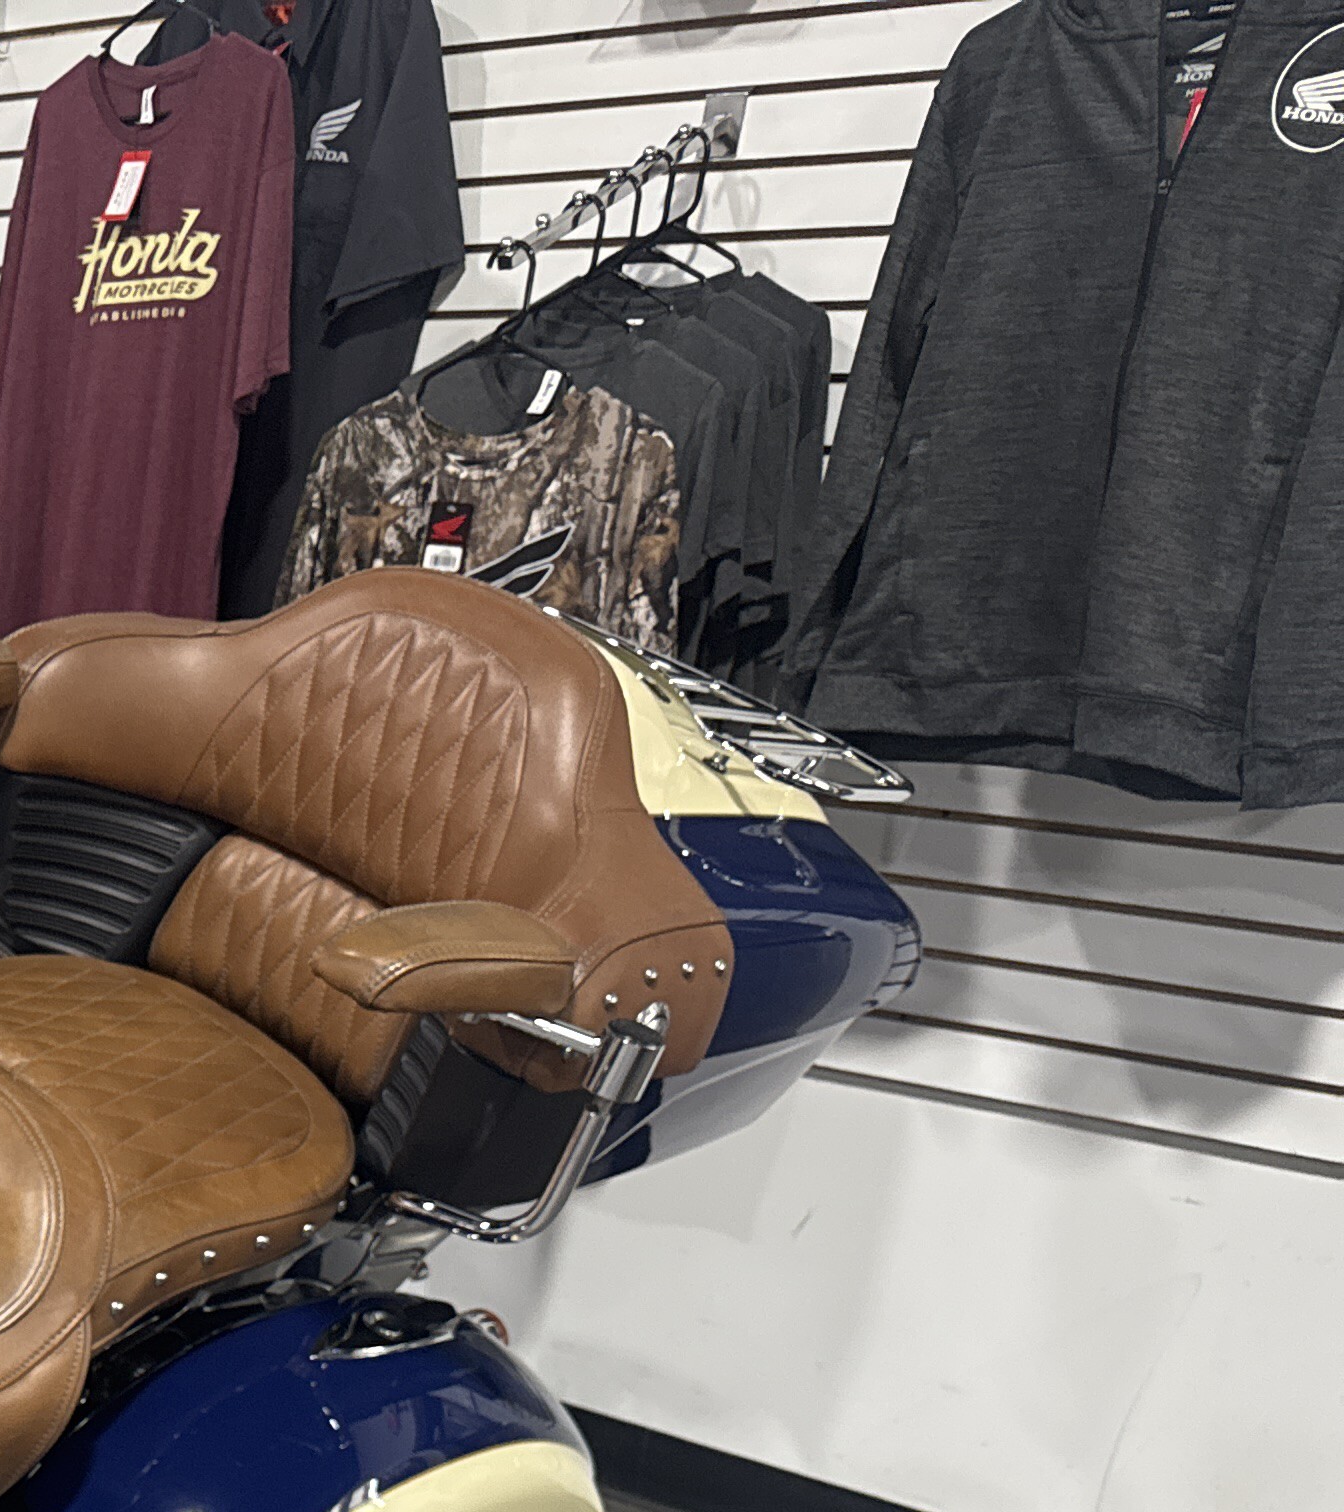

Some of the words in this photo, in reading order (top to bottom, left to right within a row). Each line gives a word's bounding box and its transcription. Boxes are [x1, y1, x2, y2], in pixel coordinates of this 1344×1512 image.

[1175, 71, 1213, 83] HON
[1282, 105, 1344, 125] HOND
[305, 149, 349, 163] NDA
